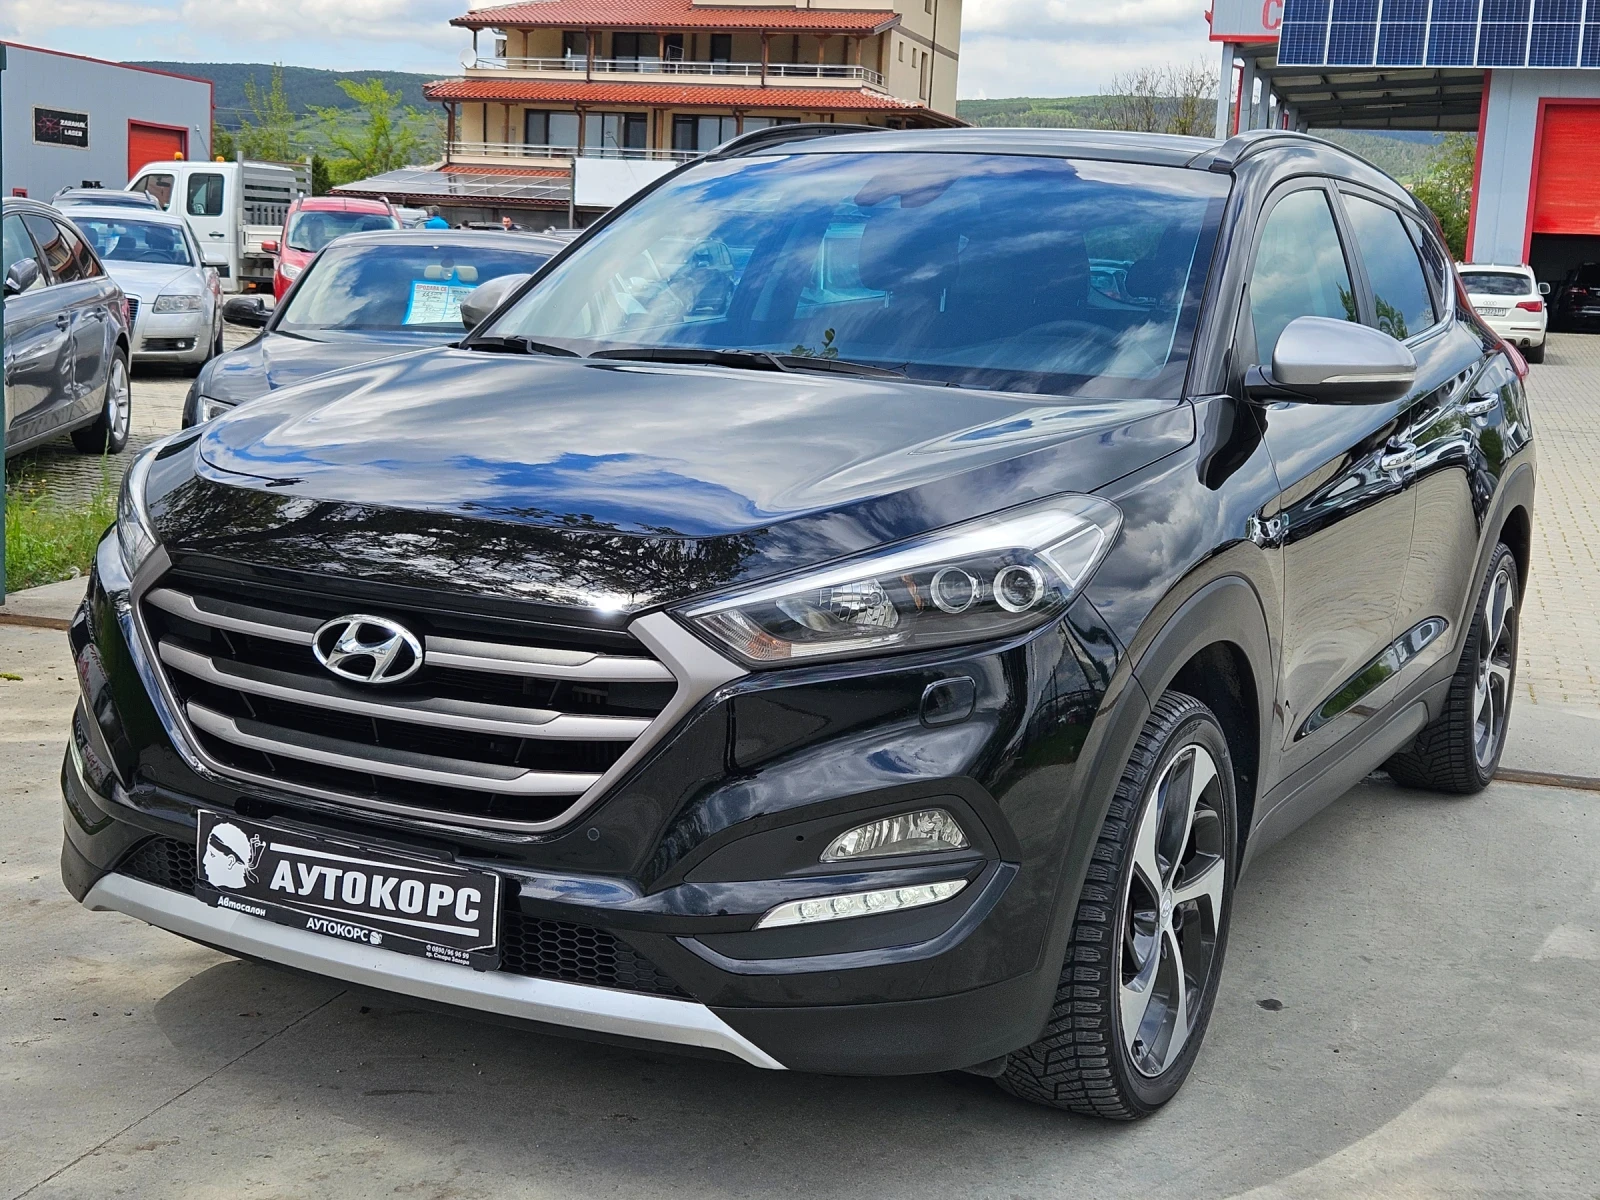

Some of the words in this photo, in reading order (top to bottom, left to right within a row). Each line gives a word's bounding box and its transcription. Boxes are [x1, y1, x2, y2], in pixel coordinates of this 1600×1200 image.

[269, 859, 481, 922] АУТОКОРС
[217, 895, 267, 917] Автосалон
[306, 917, 369, 942] АУТОКОРС
